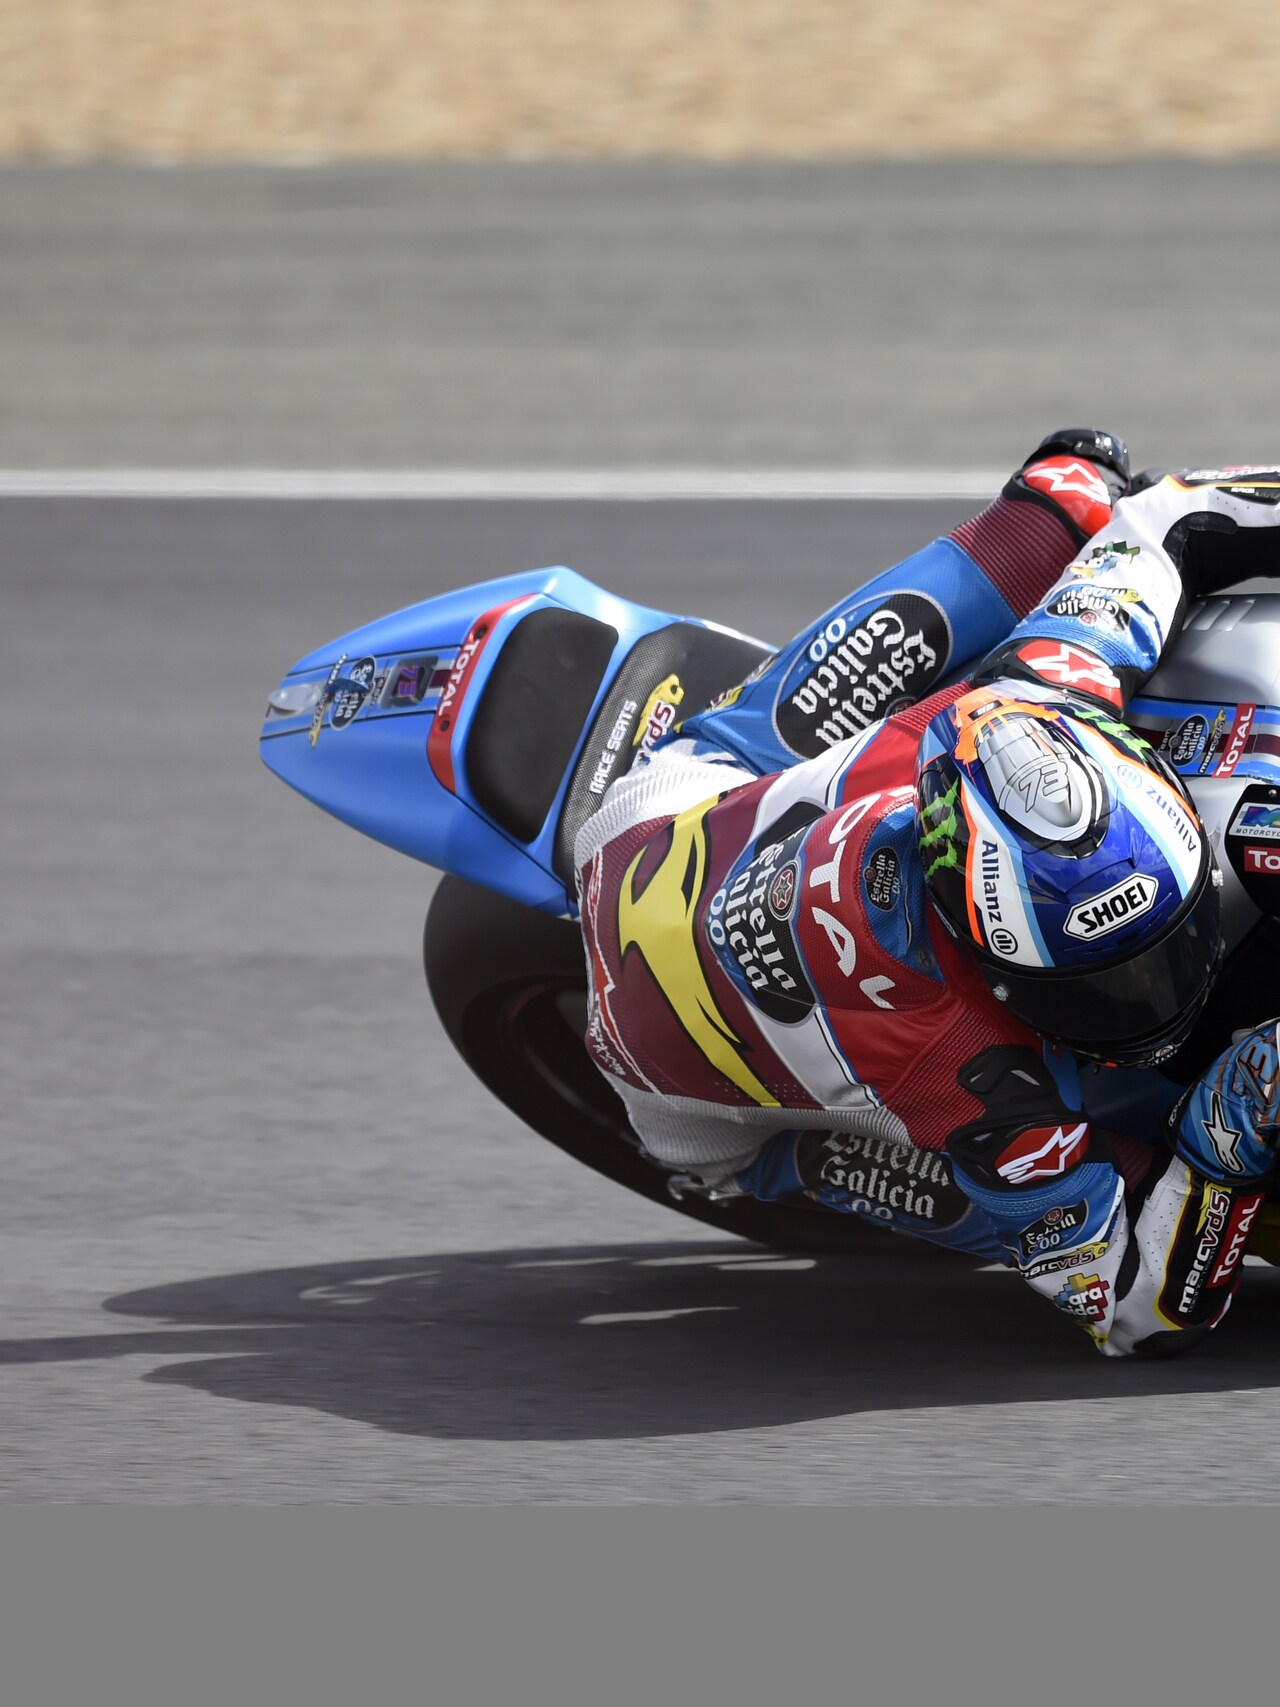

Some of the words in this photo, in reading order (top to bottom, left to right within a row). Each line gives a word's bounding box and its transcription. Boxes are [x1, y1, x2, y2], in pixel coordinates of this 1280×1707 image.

[437, 638, 480, 717] TOTAL
[791, 609, 906, 715] Galicia
[815, 629, 937, 747] Estrella
[588, 750, 616, 795] RACE
[606, 700, 638, 752] SEATS
[1215, 707, 1253, 777] TOTAL
[1017, 755, 1070, 815] 73
[1145, 788, 1197, 853] Allianz
[870, 853, 887, 904] Estrella
[879, 859, 897, 904] Galicia
[980, 840, 1004, 924] Allianz
[1076, 881, 1148, 934] SHOEI
[820, 1154, 936, 1220] Galicia
[1211, 1197, 1262, 1285] TOTAL
